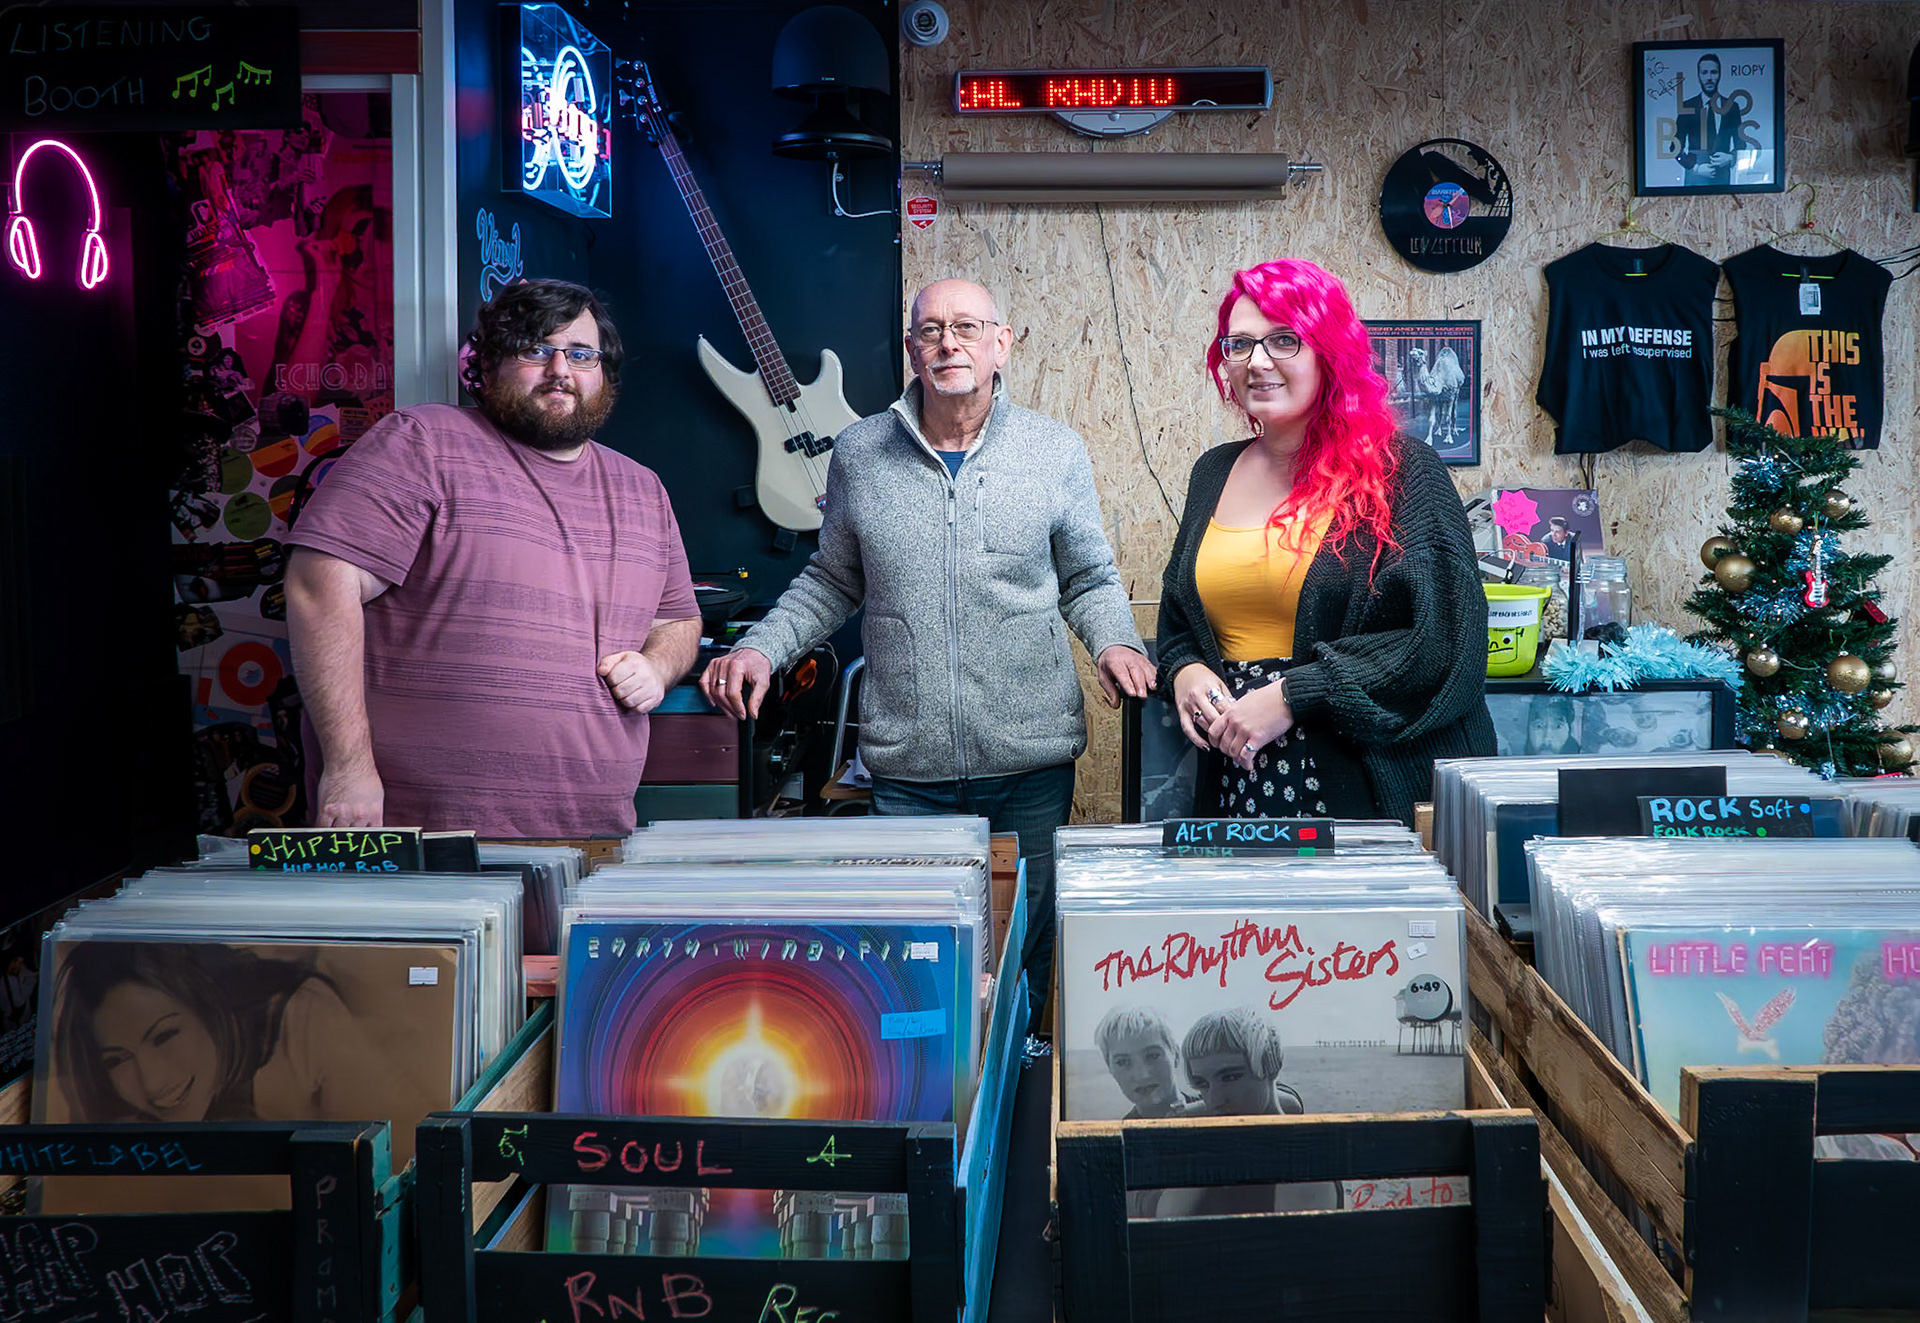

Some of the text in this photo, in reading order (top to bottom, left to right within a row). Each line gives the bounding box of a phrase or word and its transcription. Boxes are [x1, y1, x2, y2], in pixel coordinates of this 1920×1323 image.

[9, 16, 213, 54] LISTENING
[1730, 64, 1766, 77] RIOPY
[24, 75, 145, 116] BOOTH
[1581, 325, 1693, 346] IN MY DEFENSE
[1589, 348, 1609, 358] was
[1611, 342, 1631, 356] left
[1808, 330, 1861, 365] THIS
[1810, 362, 1831, 395] IS
[1809, 395, 1858, 428] THE
[1650, 797, 1795, 823] ROCK Soft
[1175, 822, 1292, 843] ALT ROCK
[1653, 825, 1751, 838] FOLK ROCK
[261, 832, 403, 862] HIP HOP
[282, 862, 313, 873] HIP
[316, 862, 346, 873] HOP
[1094, 918, 1304, 991] The Rhythm
[1651, 945, 1747, 975] LITTLE
[1264, 939, 1400, 1011] Sisters
[88, 1141, 203, 1171] LABEL
[573, 1131, 734, 1176] SOUL
